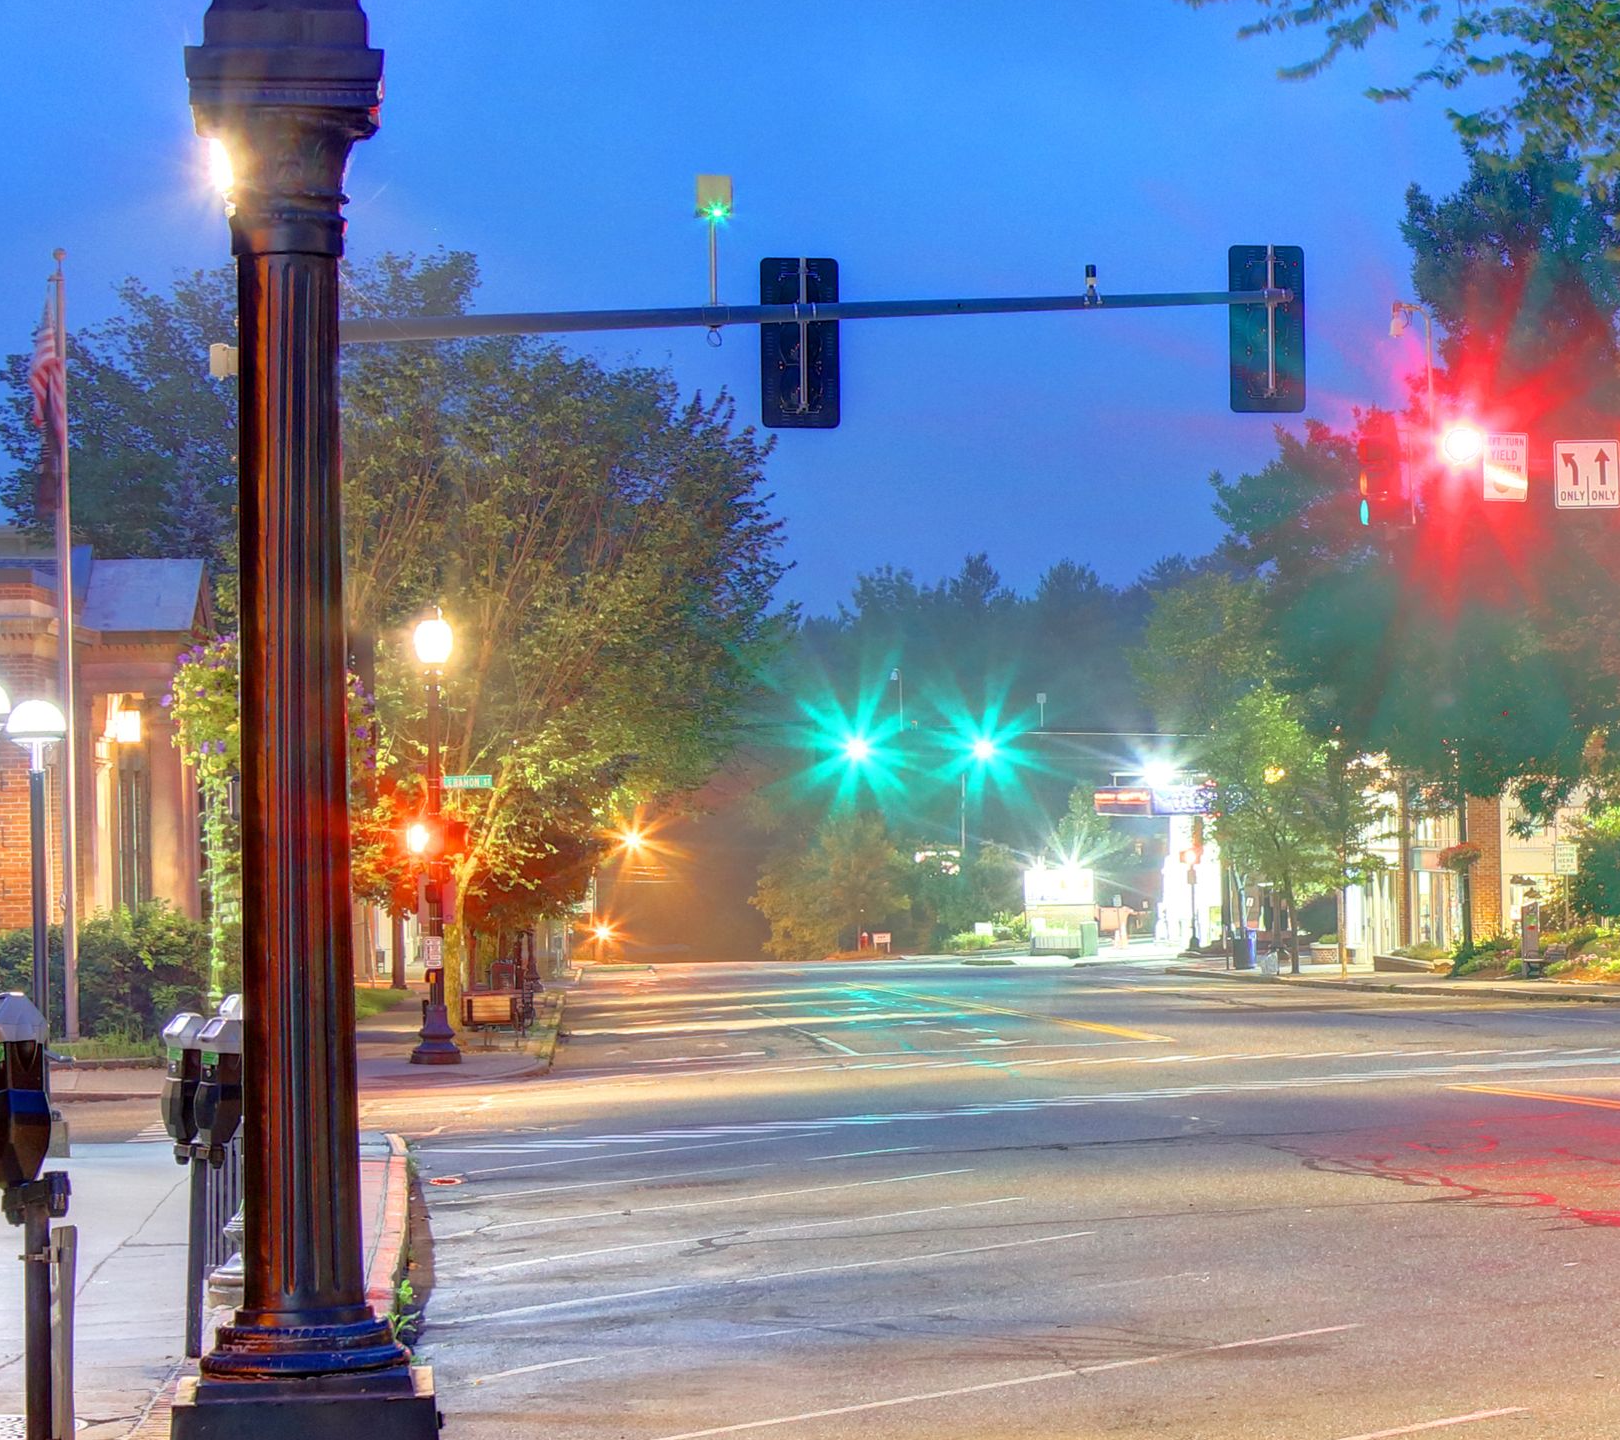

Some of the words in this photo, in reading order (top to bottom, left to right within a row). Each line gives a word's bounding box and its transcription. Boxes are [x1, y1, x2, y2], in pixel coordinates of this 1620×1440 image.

[1506, 437, 1524, 447] TURN
[1491, 450, 1517, 461] YIELD
[1560, 490, 1585, 501] ONLY
[1591, 490, 1617, 501] ONLY
